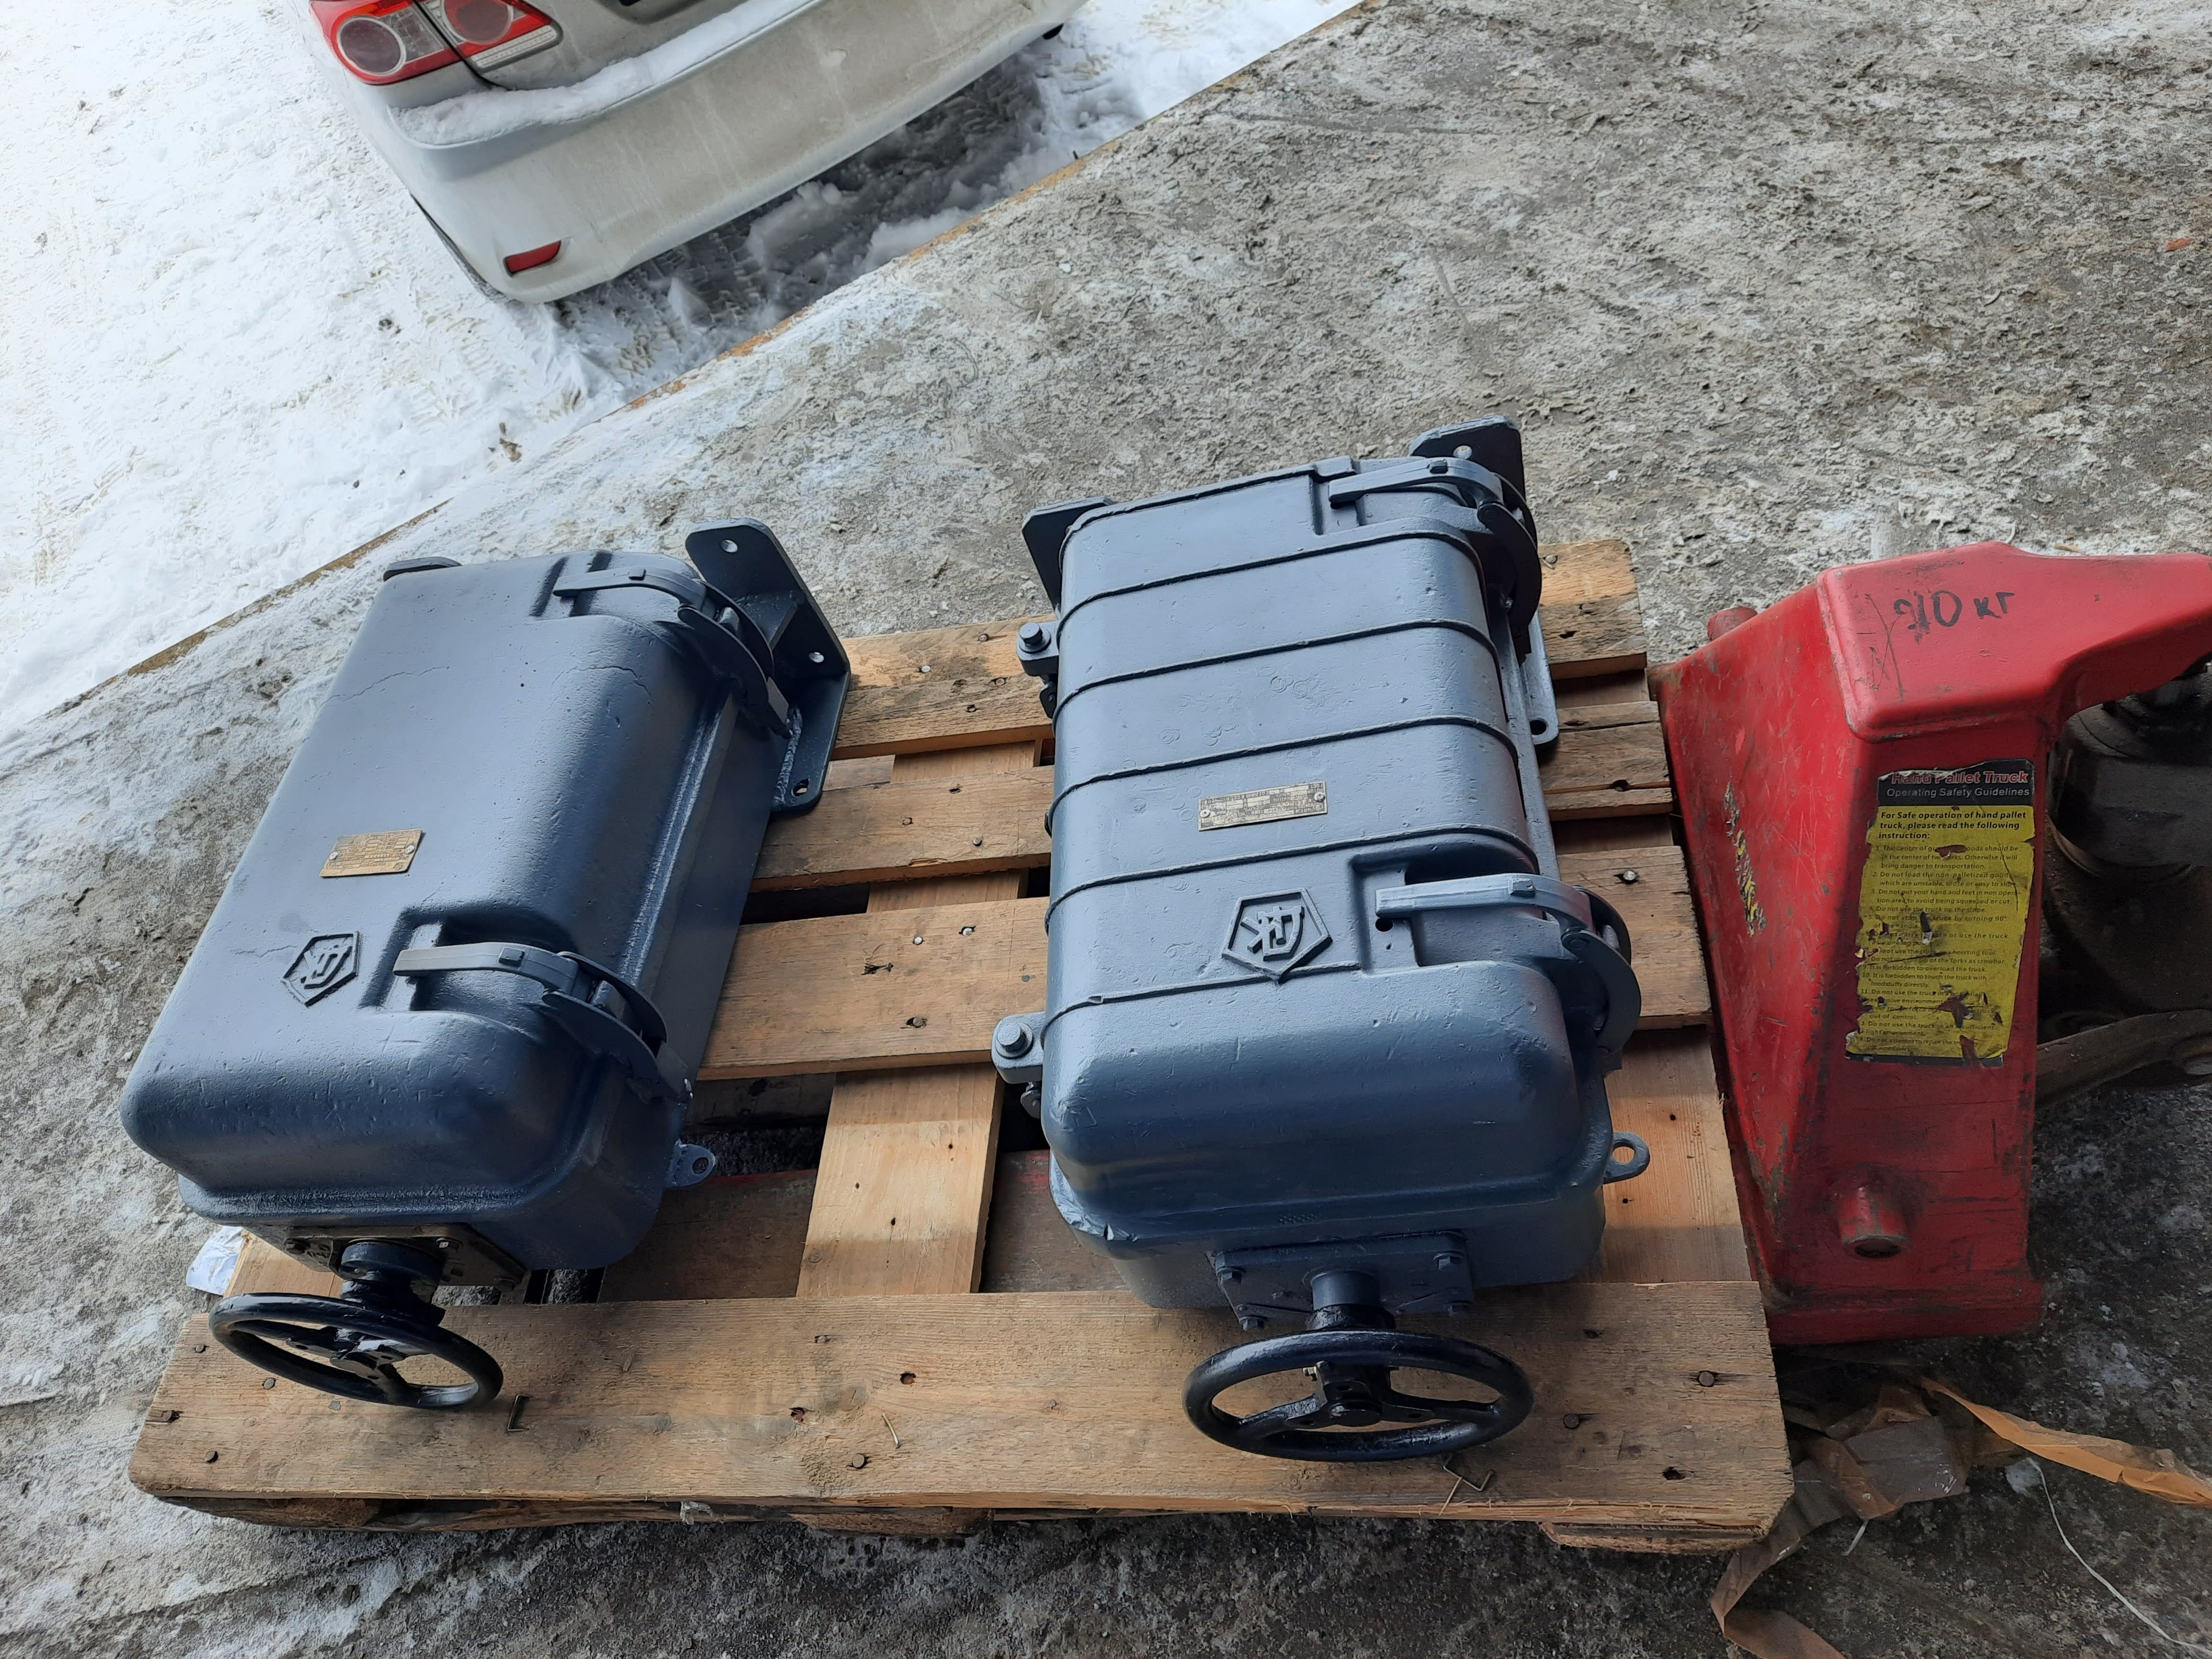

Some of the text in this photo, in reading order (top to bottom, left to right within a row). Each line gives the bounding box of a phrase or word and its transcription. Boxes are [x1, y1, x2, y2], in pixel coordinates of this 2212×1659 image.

[1983, 771, 2028, 784] Truck
[1887, 787, 2030, 798] Operating Safety Guidelines
[1918, 812, 1962, 820] operation
[2000, 812, 2026, 820] pallet
[1907, 822, 1936, 830] please
[1977, 821, 2020, 830] following
